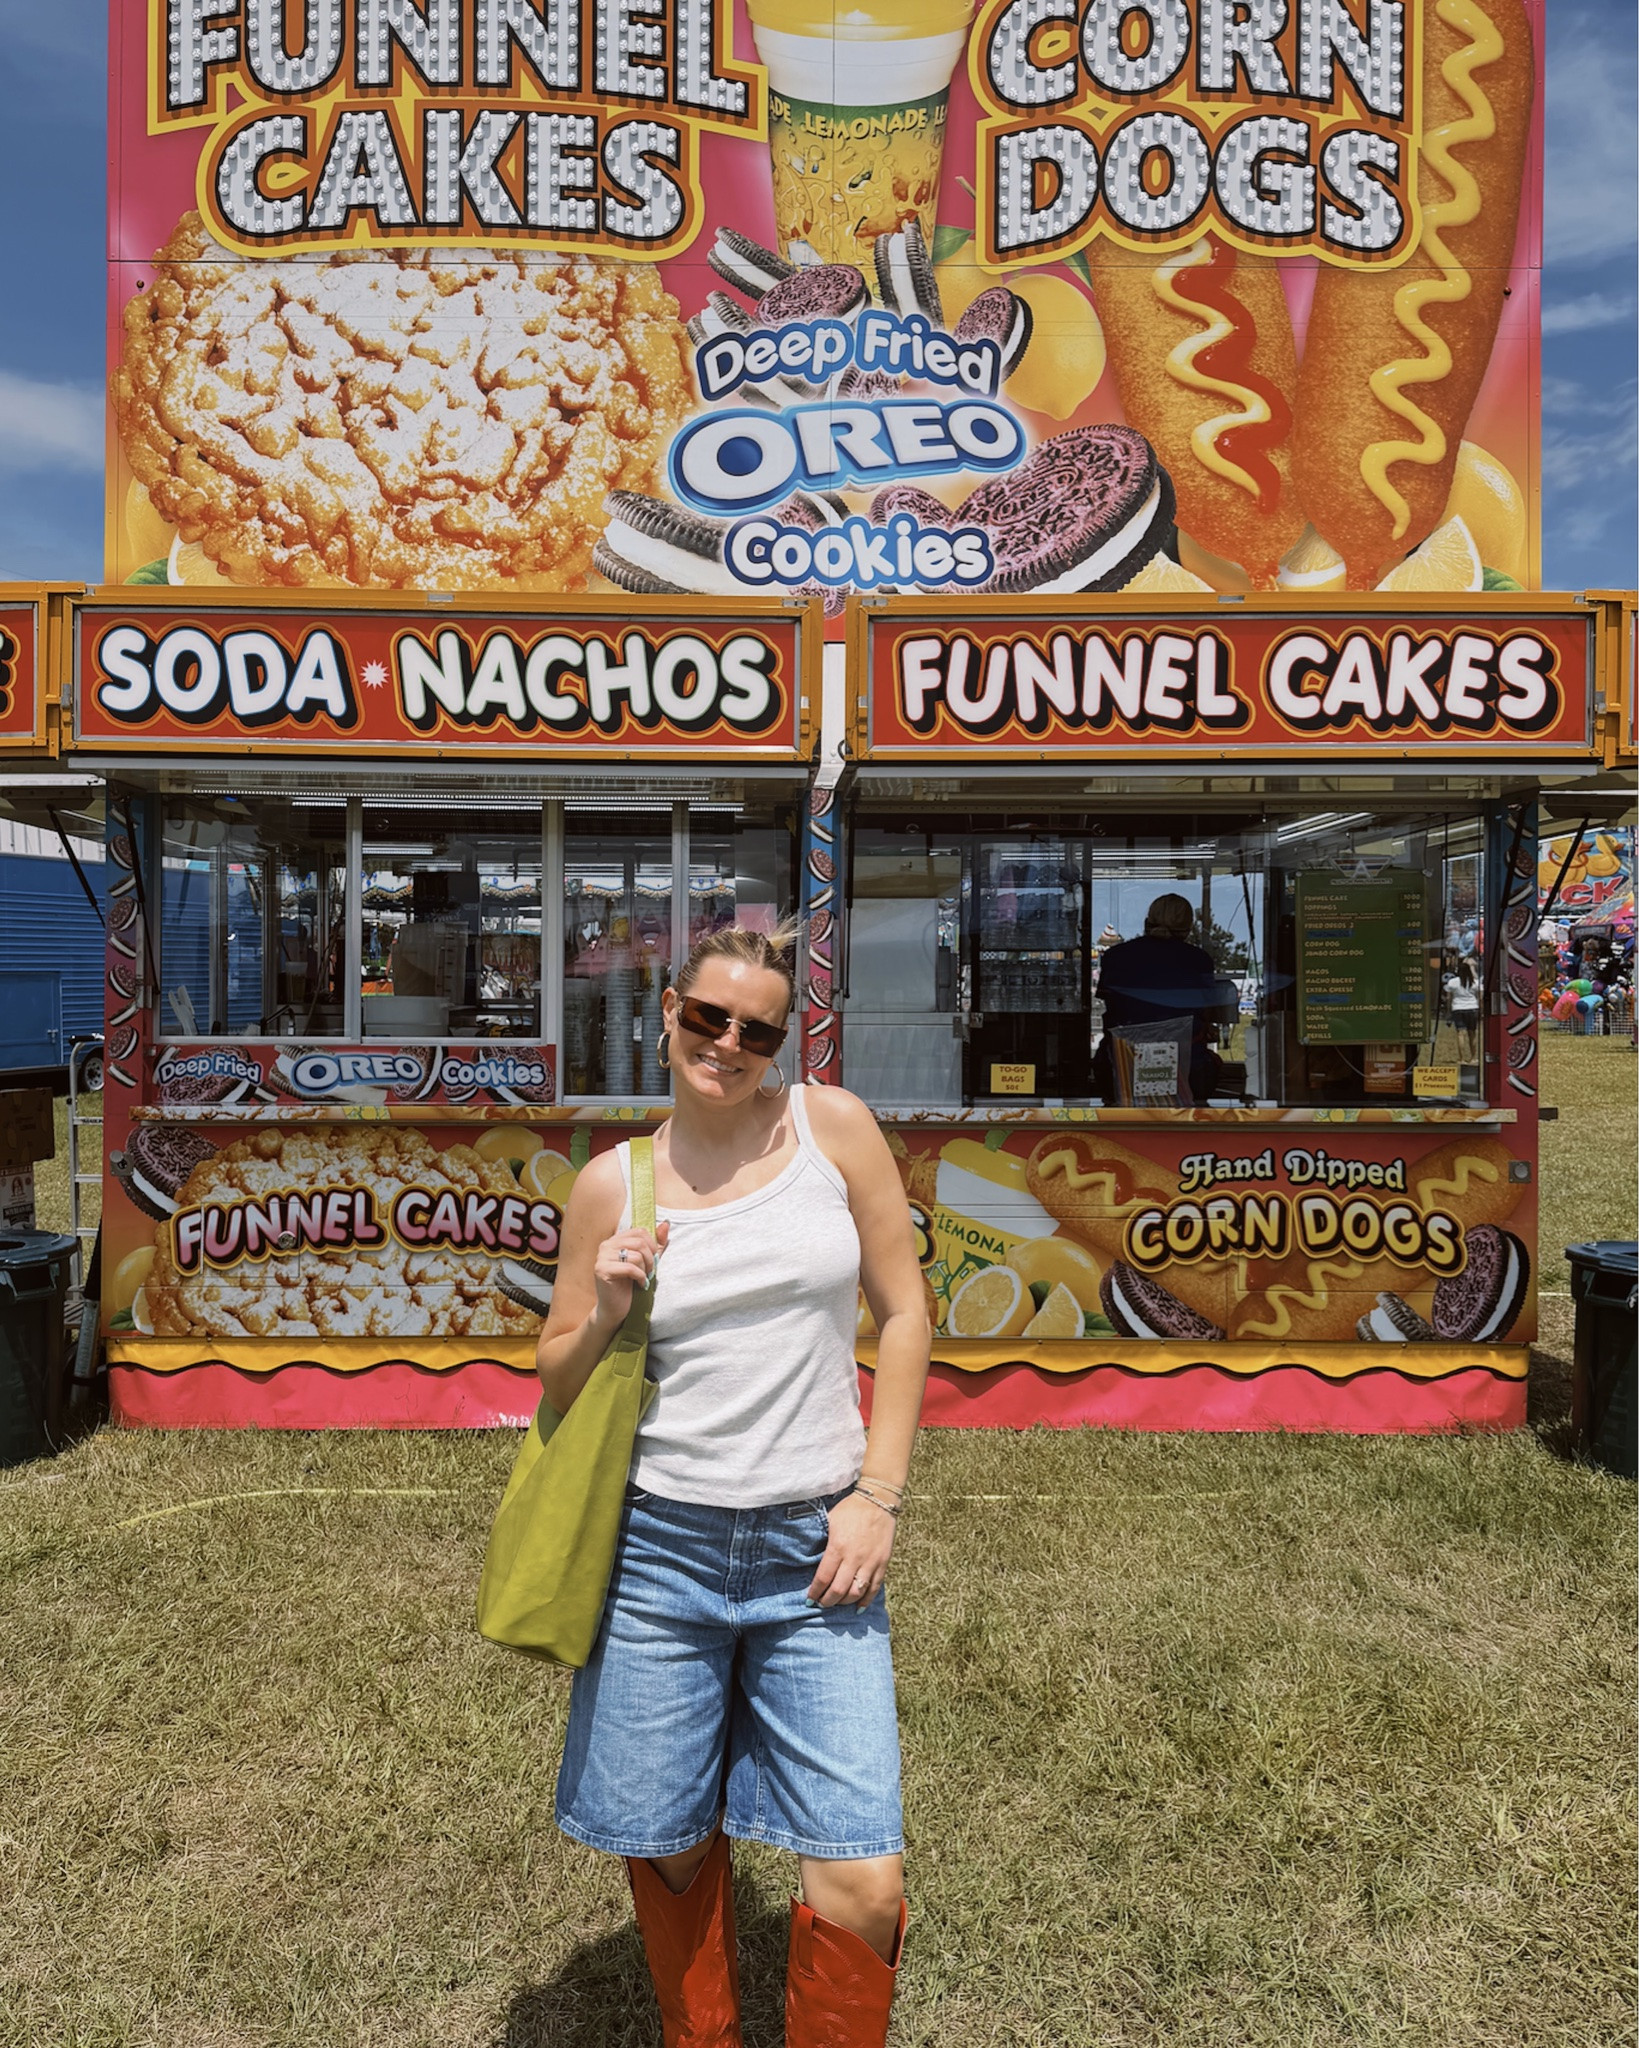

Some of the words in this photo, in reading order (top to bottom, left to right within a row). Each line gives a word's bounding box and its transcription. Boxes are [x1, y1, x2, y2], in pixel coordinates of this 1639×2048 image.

[166, 0, 752, 117] FUNNEL
[985, 0, 1404, 121] CORN
[802, 107, 929, 140] LEMONADE
[215, 103, 685, 240] CAKES
[990, 110, 1409, 254] DOGS
[702, 324, 849, 396] Deep
[862, 318, 997, 396] Fried
[680, 403, 1020, 502] OREO
[729, 519, 990, 583] Cookies
[99, 627, 354, 724] SODA
[398, 629, 775, 726] NACHOS
[901, 633, 1246, 726] FUNNEL
[1268, 633, 1552, 726] CAKES
[160, 1055, 208, 1083] Deep
[213, 1055, 261, 1084] Fried
[297, 1055, 421, 1091] OREO
[441, 1058, 545, 1087] Cookies
[1001, 1075, 1025, 1083] BAGS
[1180, 1149, 1275, 1191] Hand
[1283, 1149, 1406, 1193] Dipped
[176, 1190, 383, 1267] FUNNEL
[394, 1191, 559, 1256] CAKES
[937, 1217, 1015, 1255] LEMONA
[1129, 1198, 1283, 1264] CORN
[1301, 1197, 1460, 1268] DOGS
